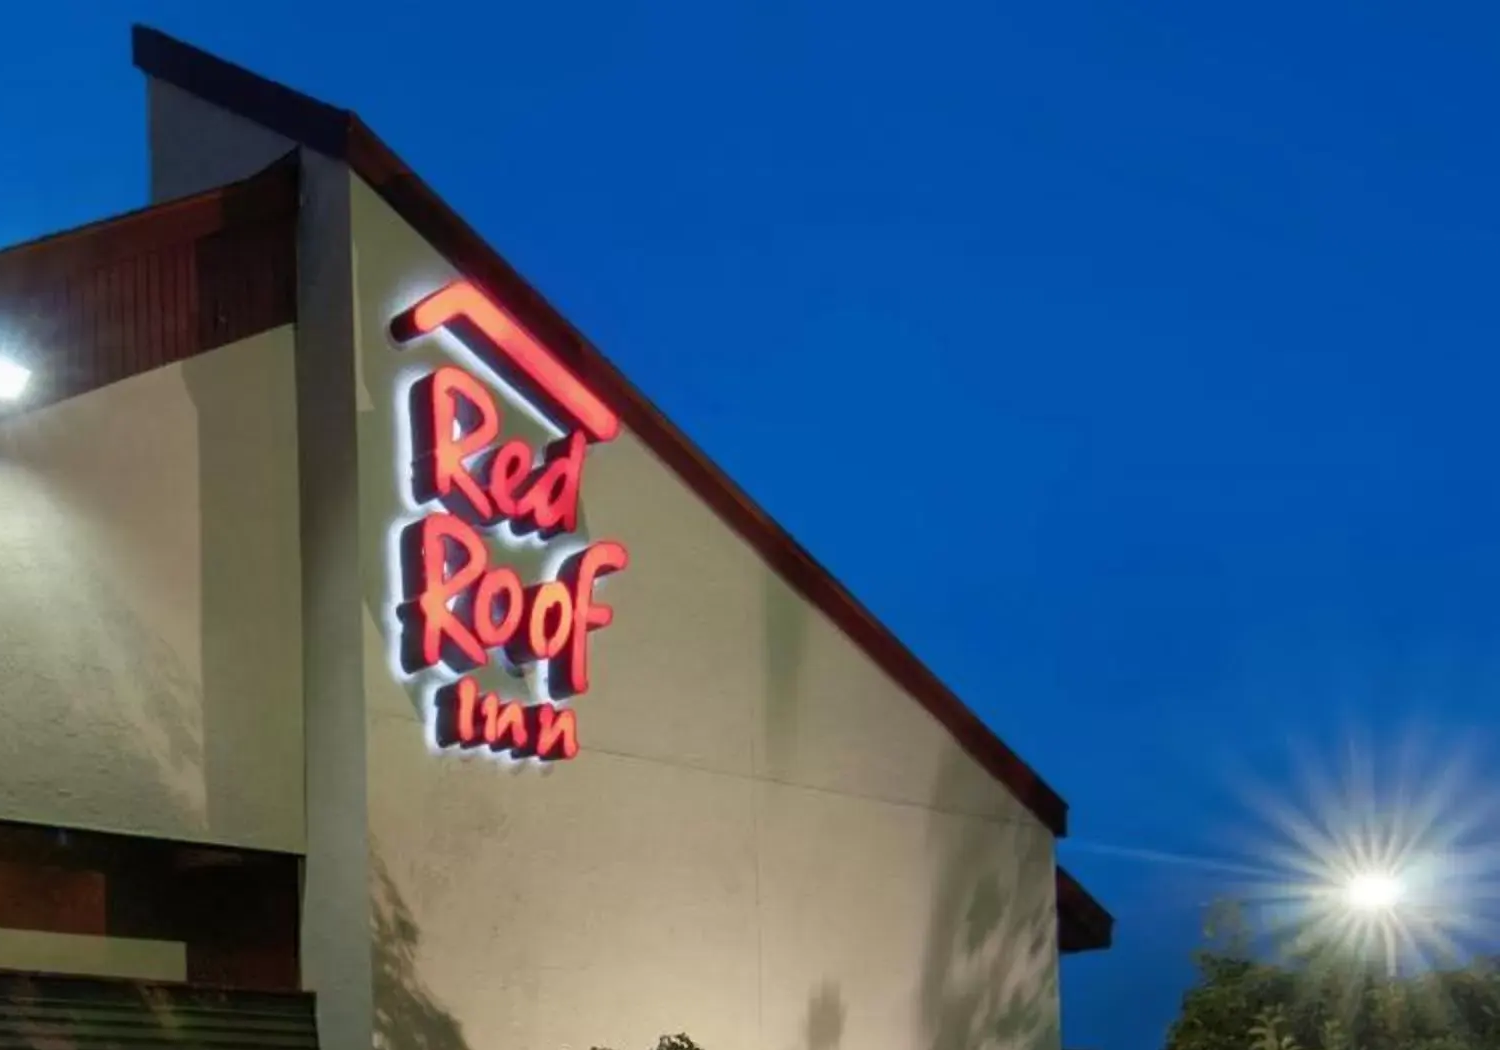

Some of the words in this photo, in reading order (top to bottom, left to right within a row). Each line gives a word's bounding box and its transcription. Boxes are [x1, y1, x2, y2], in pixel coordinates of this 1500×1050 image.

[428, 366, 586, 535] Red
[418, 513, 628, 695] Roof
[450, 676, 579, 761] Inn
